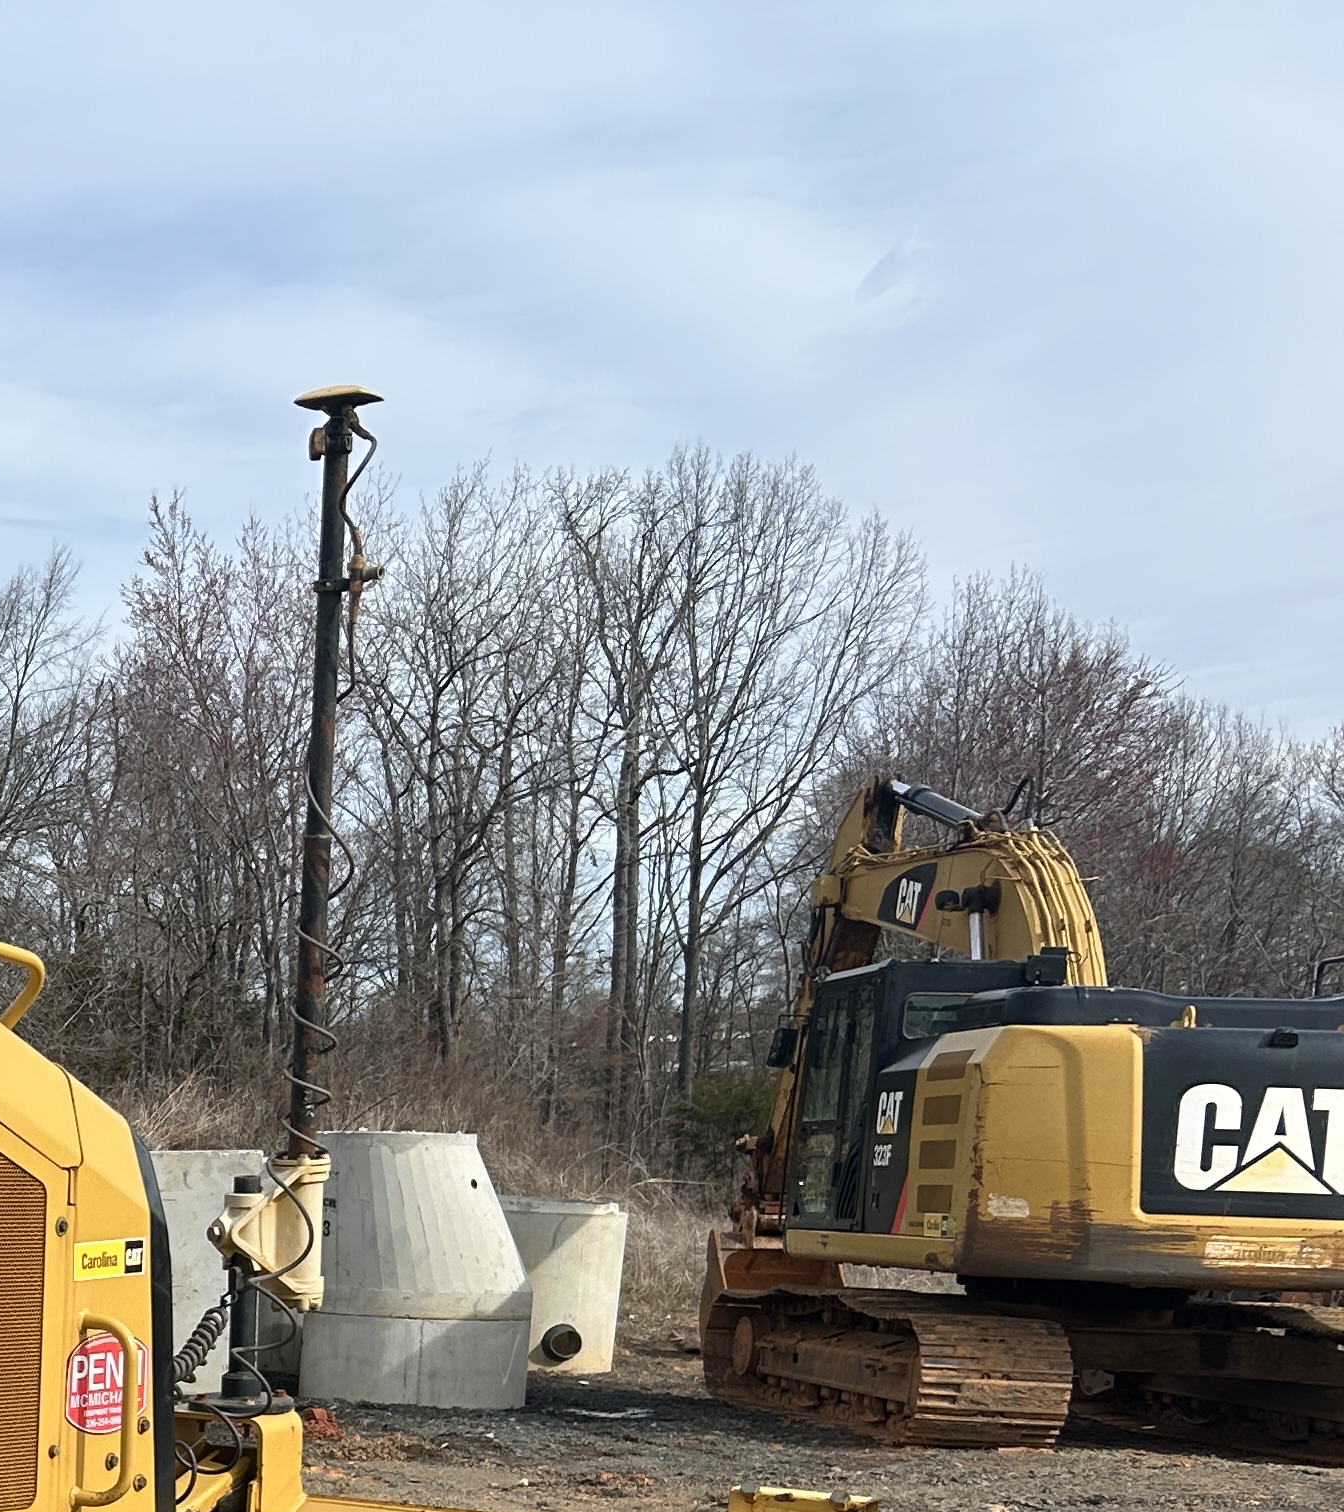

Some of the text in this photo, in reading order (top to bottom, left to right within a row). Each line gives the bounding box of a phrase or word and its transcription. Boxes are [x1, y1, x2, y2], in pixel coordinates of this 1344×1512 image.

[895, 877, 922, 925] CAT
[876, 1091, 904, 1135] CAT
[1174, 1083, 1344, 1196] CAT
[81, 1250, 118, 1270] Carolina
[70, 1389, 142, 1409] MCMICH
